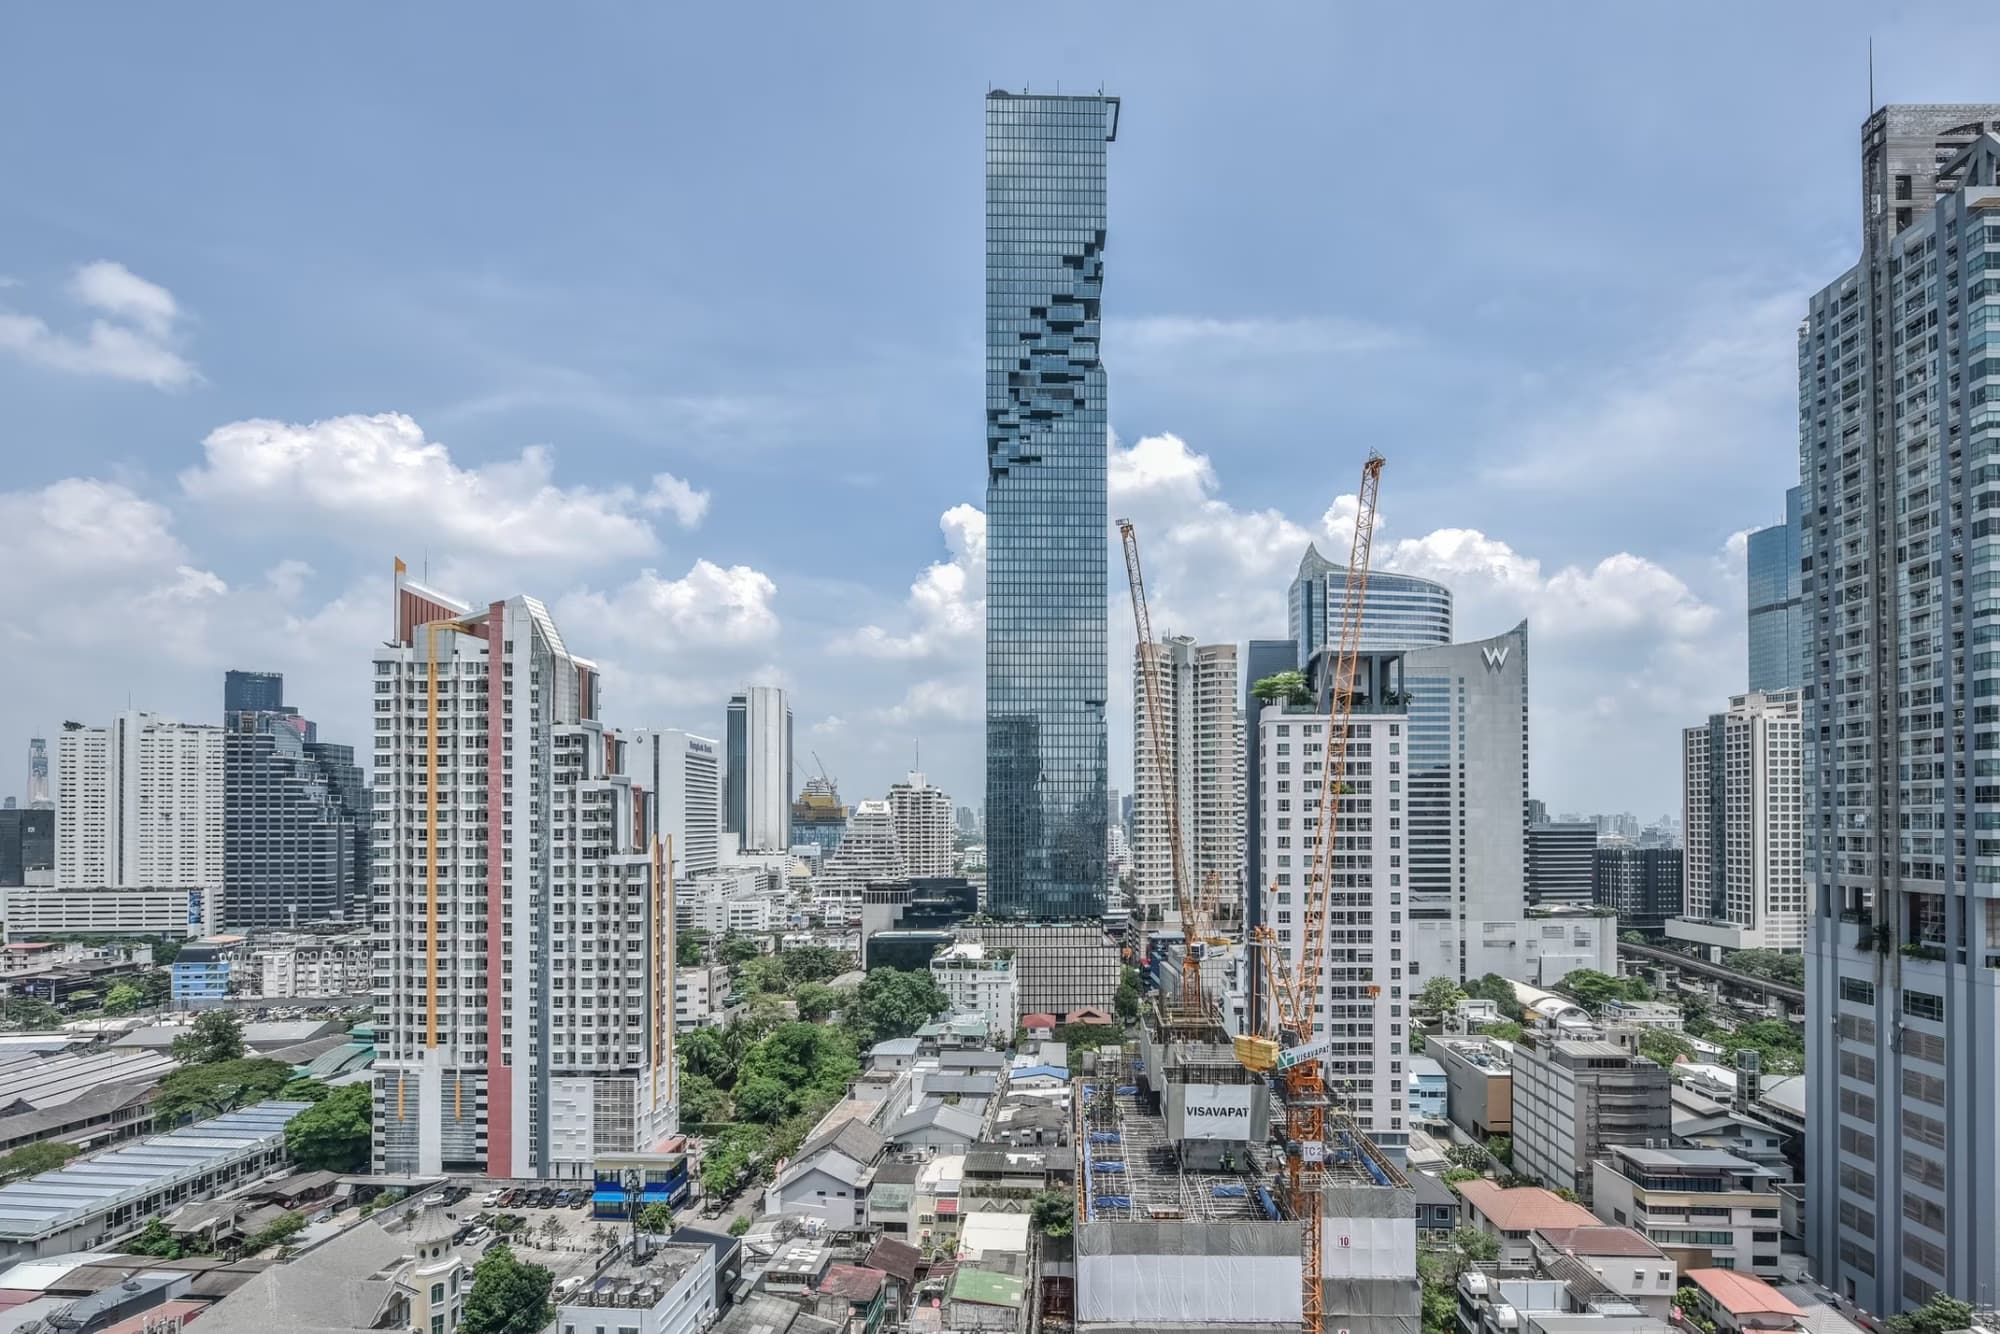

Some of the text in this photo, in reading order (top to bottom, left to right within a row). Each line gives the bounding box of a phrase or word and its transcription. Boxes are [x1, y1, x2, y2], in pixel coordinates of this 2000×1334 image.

[1482, 647, 1509, 667] W
[1296, 1045, 1329, 1062] VISAVAPAT
[1186, 1106, 1249, 1118] VISAVAPAT
[1340, 1236, 1349, 1246] 10
